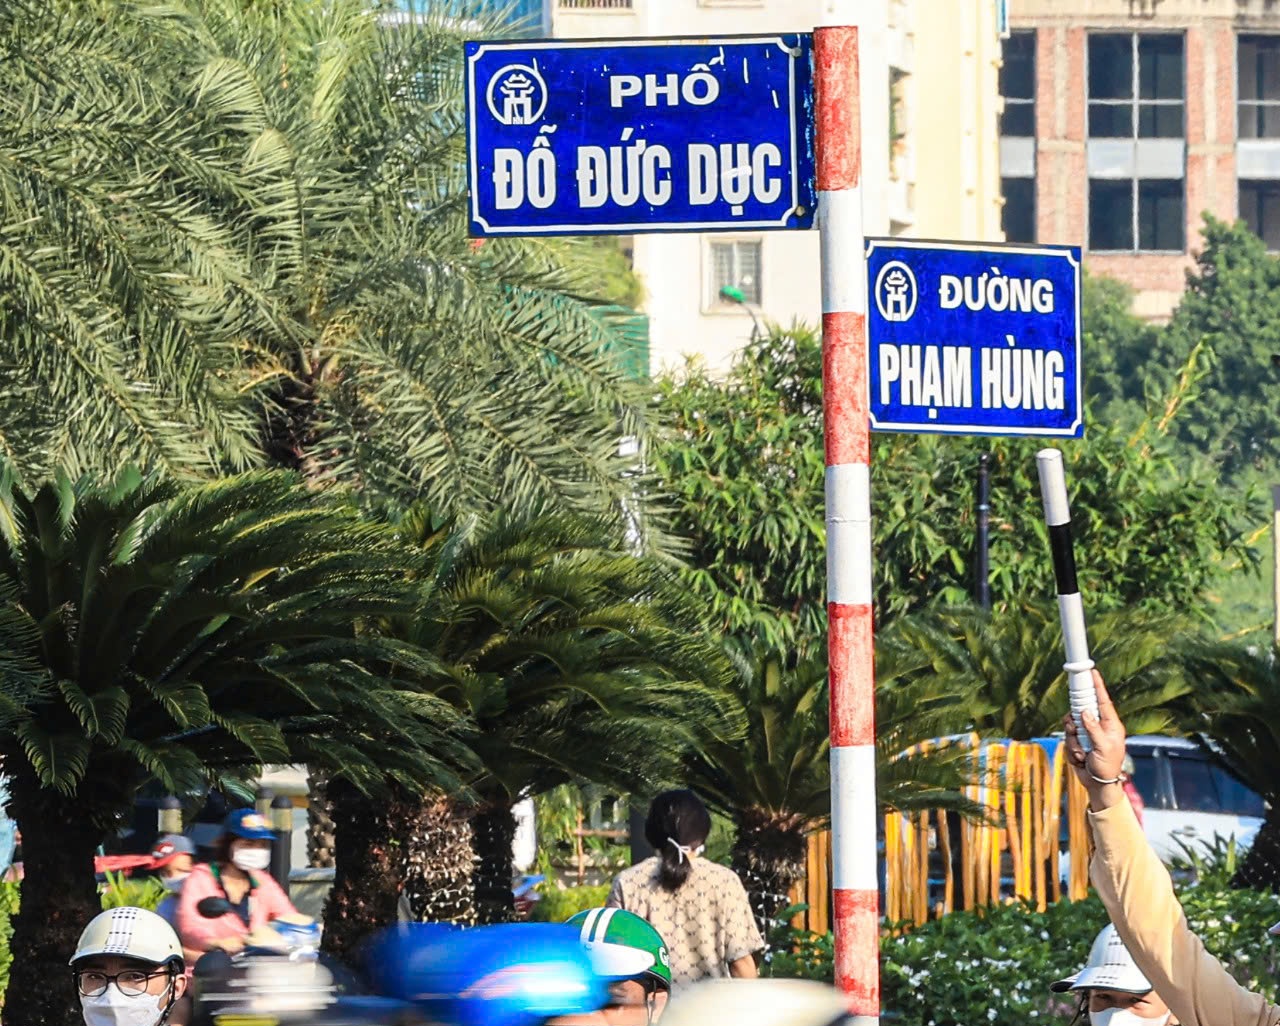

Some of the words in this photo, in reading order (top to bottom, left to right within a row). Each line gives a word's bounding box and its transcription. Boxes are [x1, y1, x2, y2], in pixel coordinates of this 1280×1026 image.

[609, 46, 726, 109] PHỐ
[492, 124, 557, 211] ĐỖ
[576, 127, 673, 209] ĐỨC
[689, 141, 782, 216] DỤC
[938, 270, 1055, 315] ĐƯỜNG
[879, 343, 973, 420] PHẠM
[981, 335, 1065, 411] HÙNG
